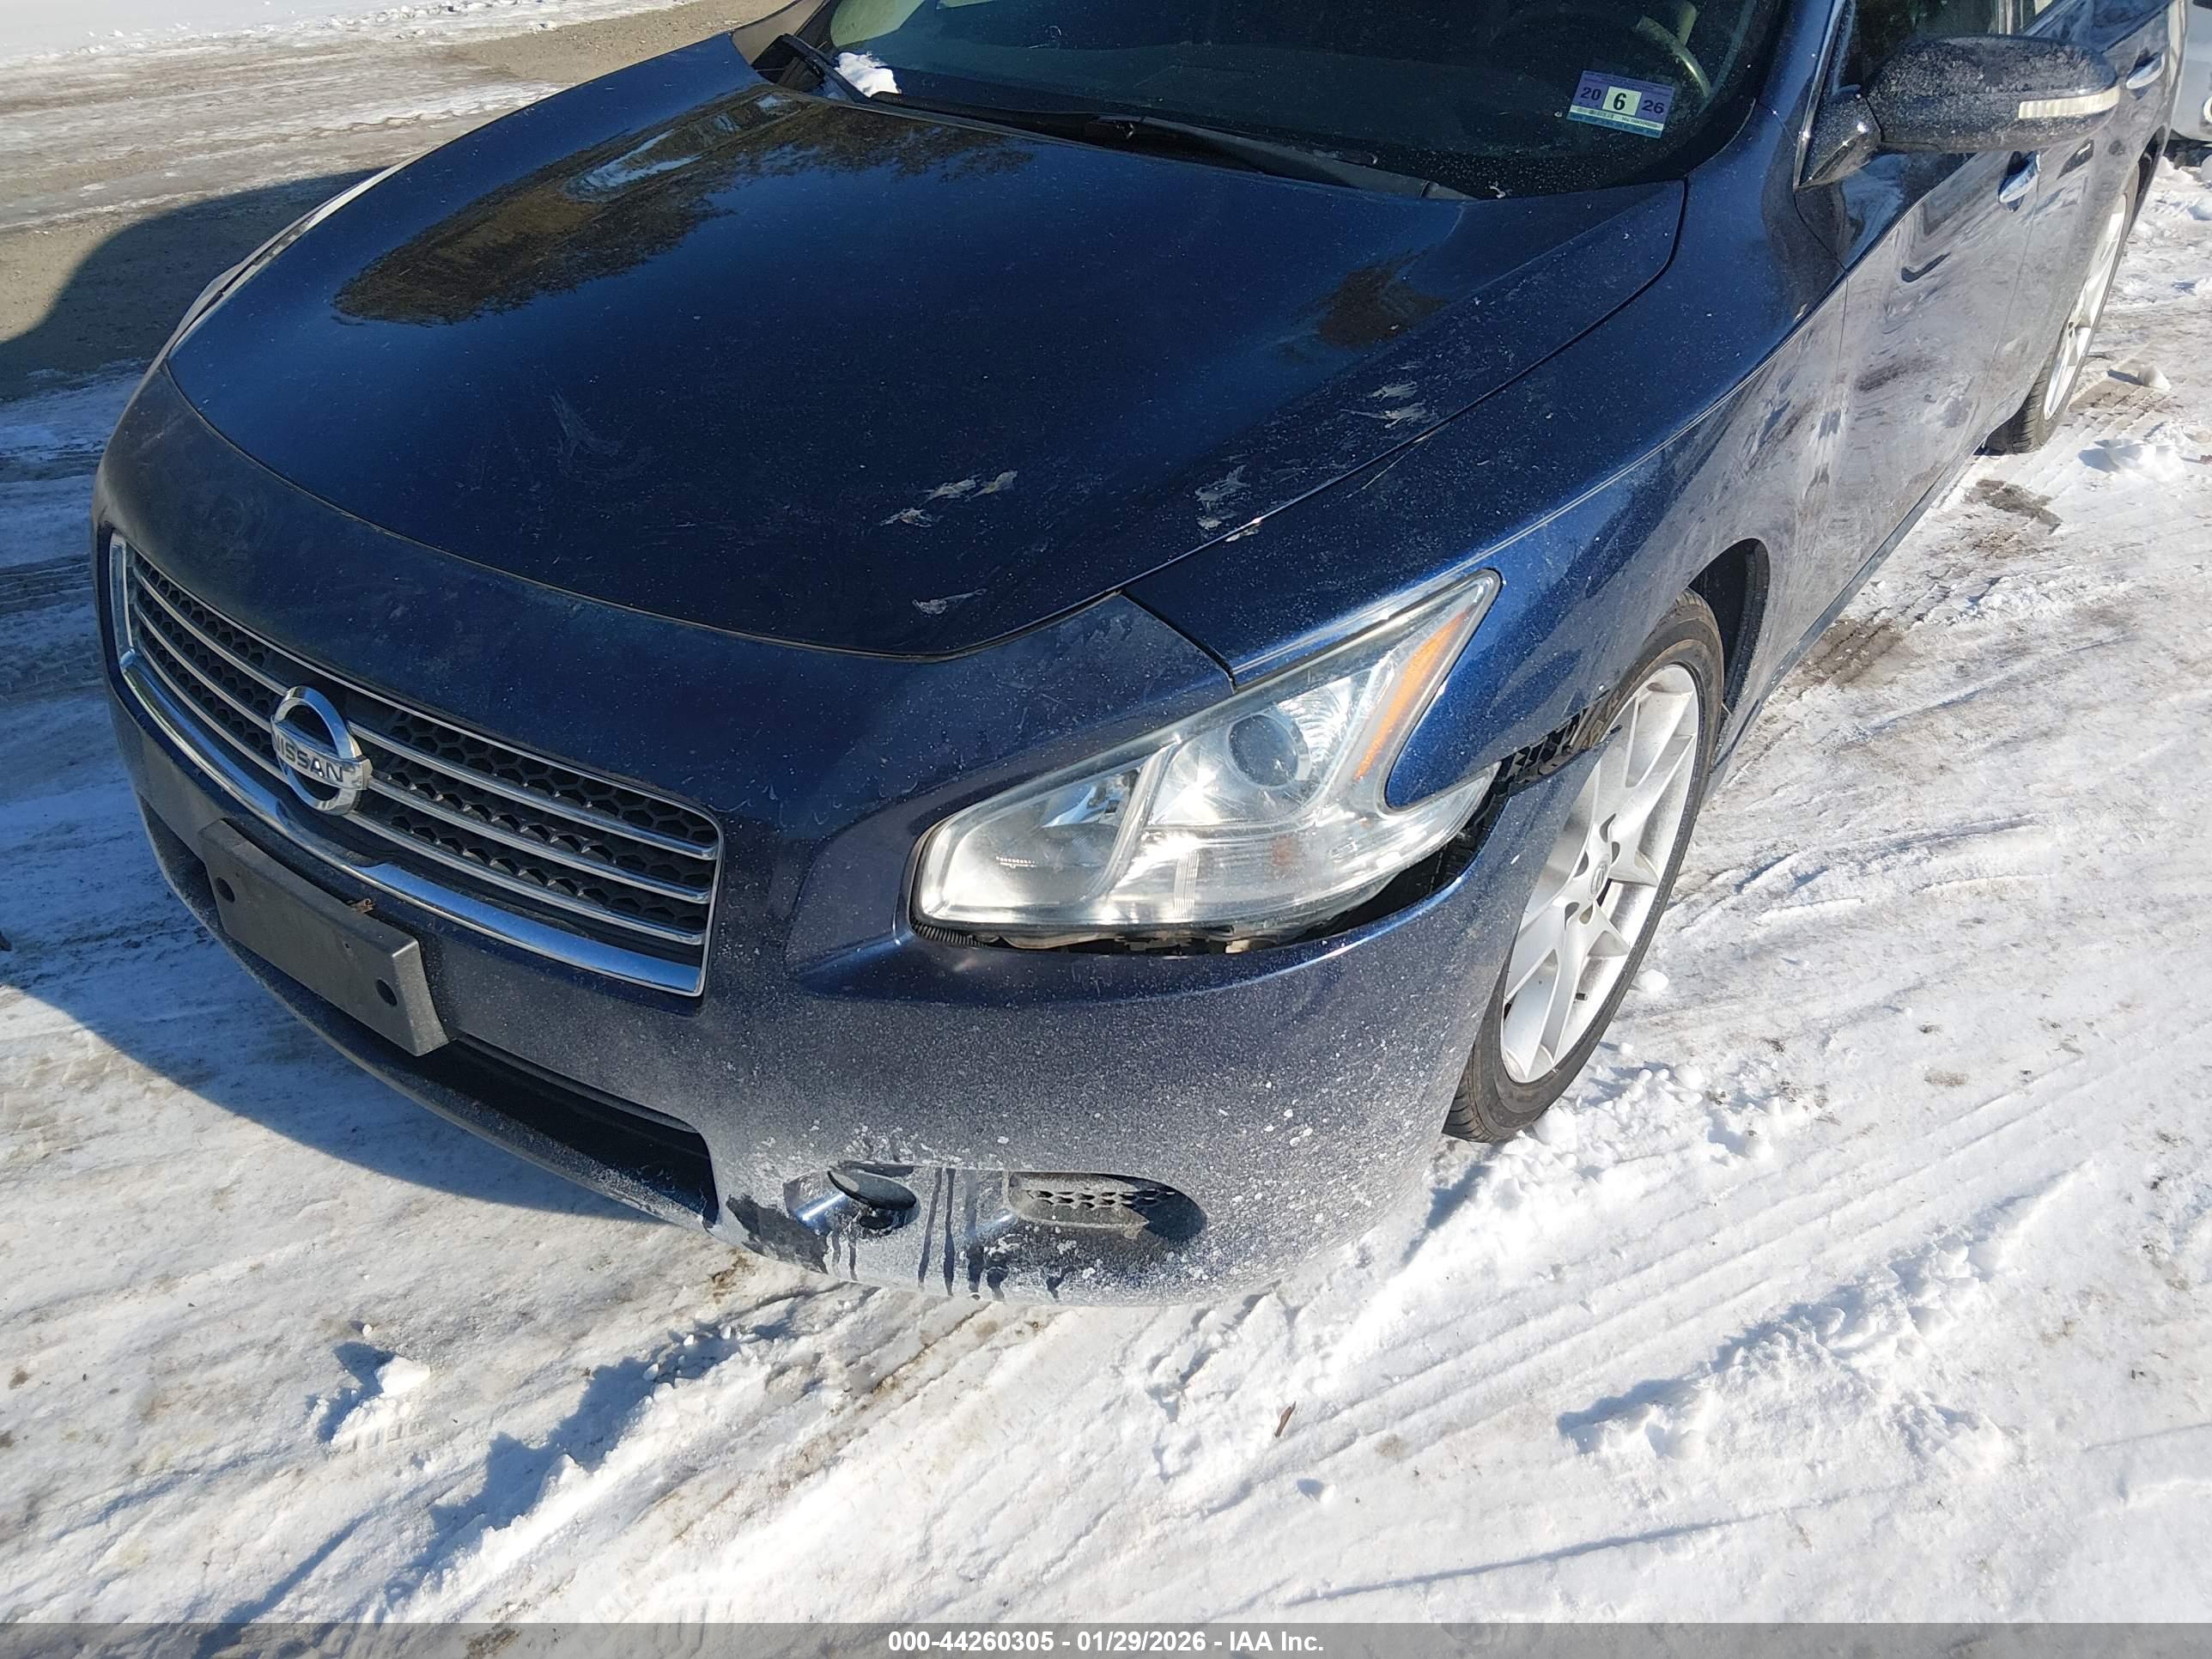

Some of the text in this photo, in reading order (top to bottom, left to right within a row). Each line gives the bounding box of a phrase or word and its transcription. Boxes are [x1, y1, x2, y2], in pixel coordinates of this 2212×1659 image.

[1580, 87, 1665, 114] 20 6 26
[273, 732, 343, 782] NISSAN
